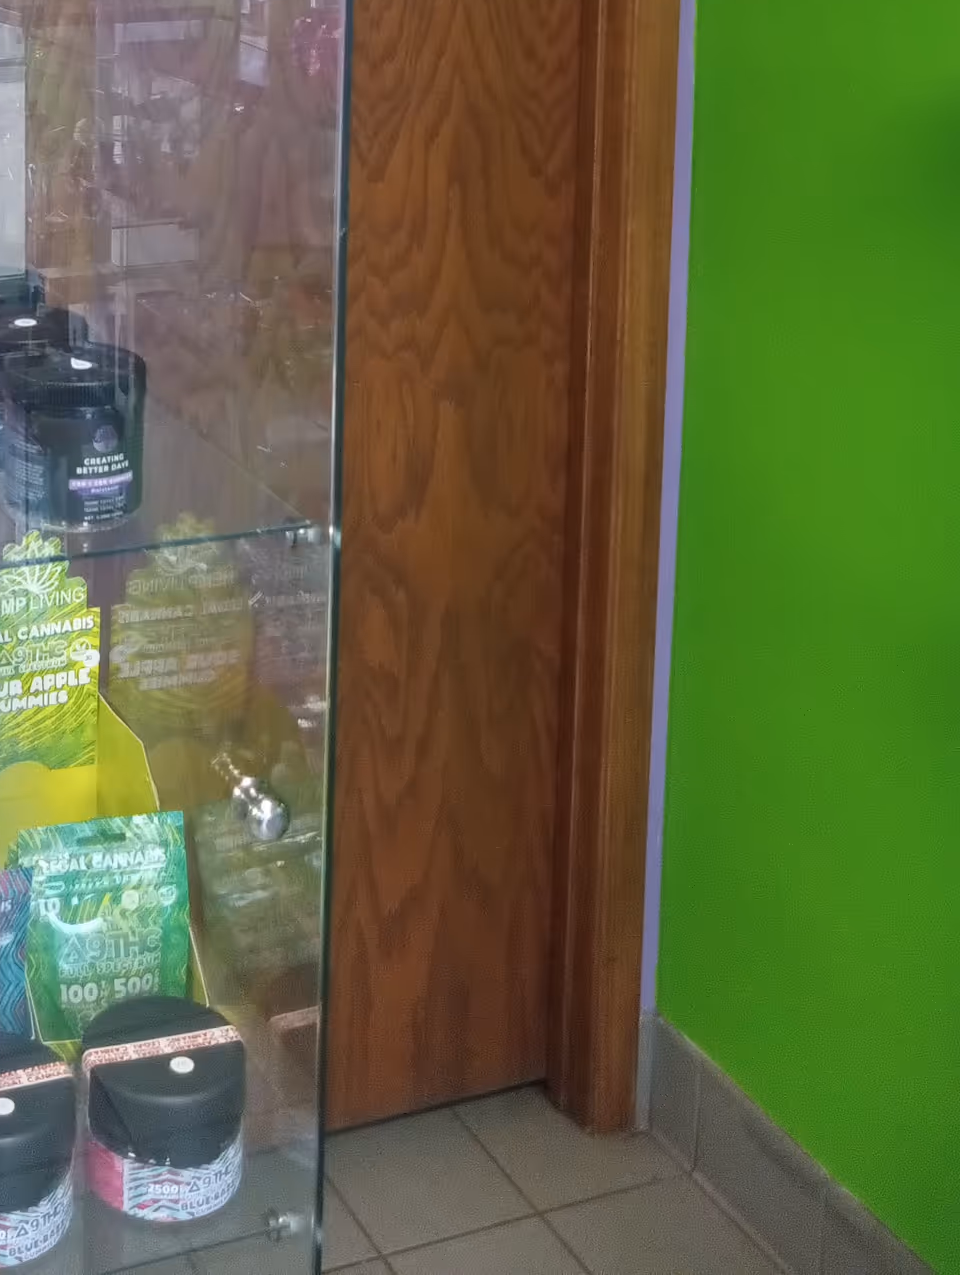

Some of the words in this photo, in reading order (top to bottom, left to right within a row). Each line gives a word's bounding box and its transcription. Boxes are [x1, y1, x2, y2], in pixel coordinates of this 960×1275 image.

[83, 453, 125, 467] CREATING
[29, 587, 87, 610] LIVING
[17, 616, 95, 640] CANNABIS
[29, 668, 91, 694] APPLE
[59, 982, 98, 1004] 100
[113, 972, 153, 999] 500
